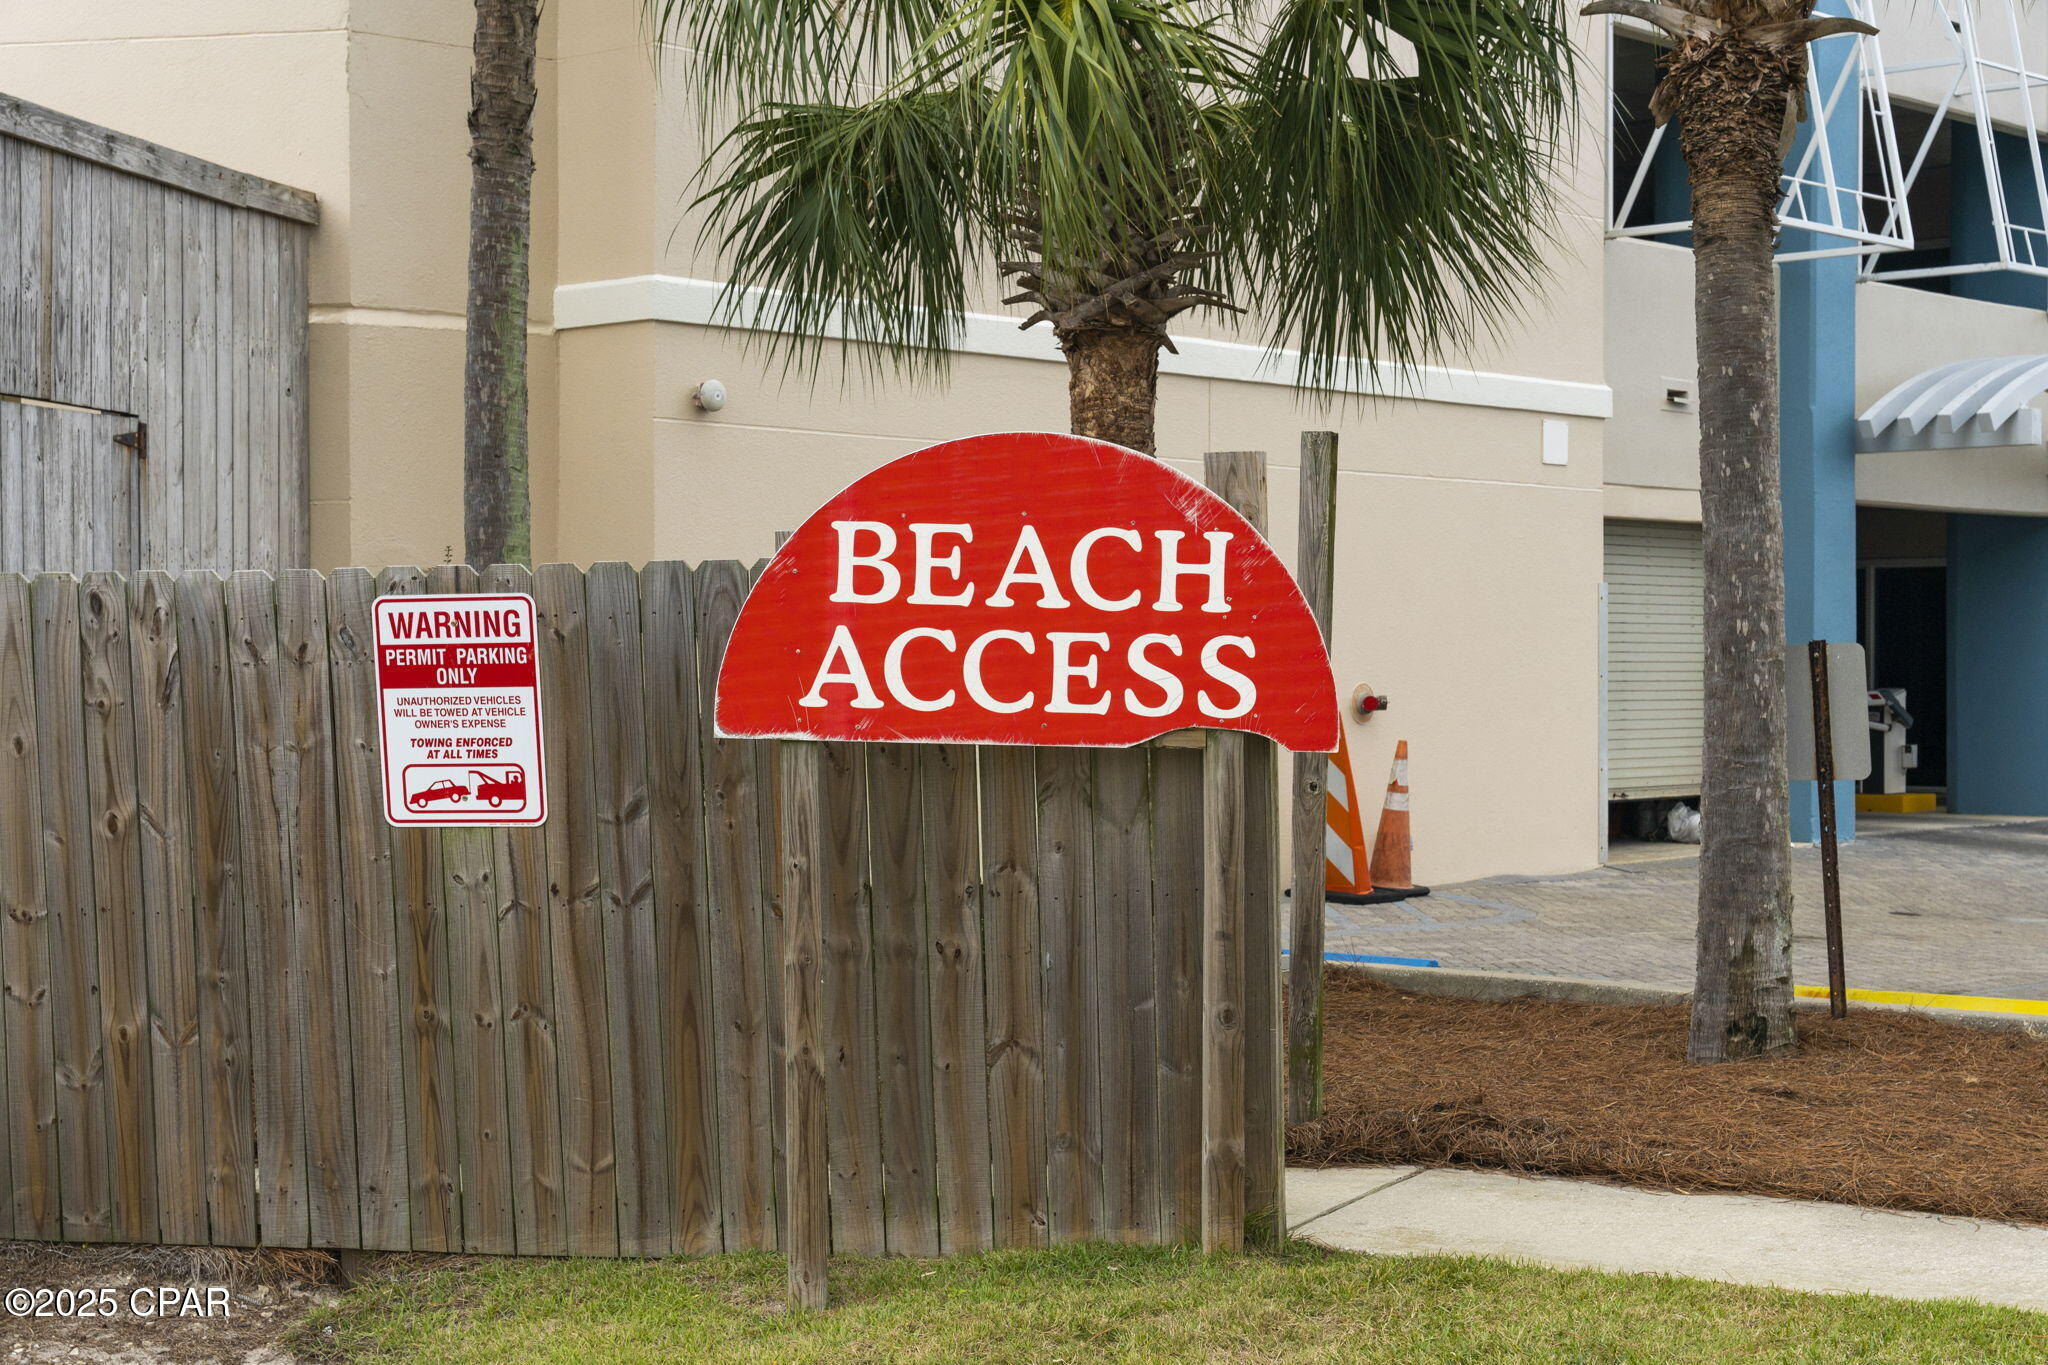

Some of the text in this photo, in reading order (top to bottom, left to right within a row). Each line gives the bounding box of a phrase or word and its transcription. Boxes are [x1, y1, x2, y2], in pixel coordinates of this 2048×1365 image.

[829, 520, 1234, 613] BEACH
[388, 609, 521, 639] WARNING
[386, 647, 527, 666] PERMIT PARKING
[436, 668, 477, 684] ONLY
[798, 625, 1257, 719] ACCESS
[397, 696, 521, 706] UNAUTHORIZED VEHICLES
[394, 707, 526, 717] WILL BE TOWED AT VEHICLE
[415, 719, 506, 728] OWNER'S EXPENSE
[411, 738, 513, 748] TOWING ENFORCED
[427, 749, 498, 759] AT ALL TIMES
